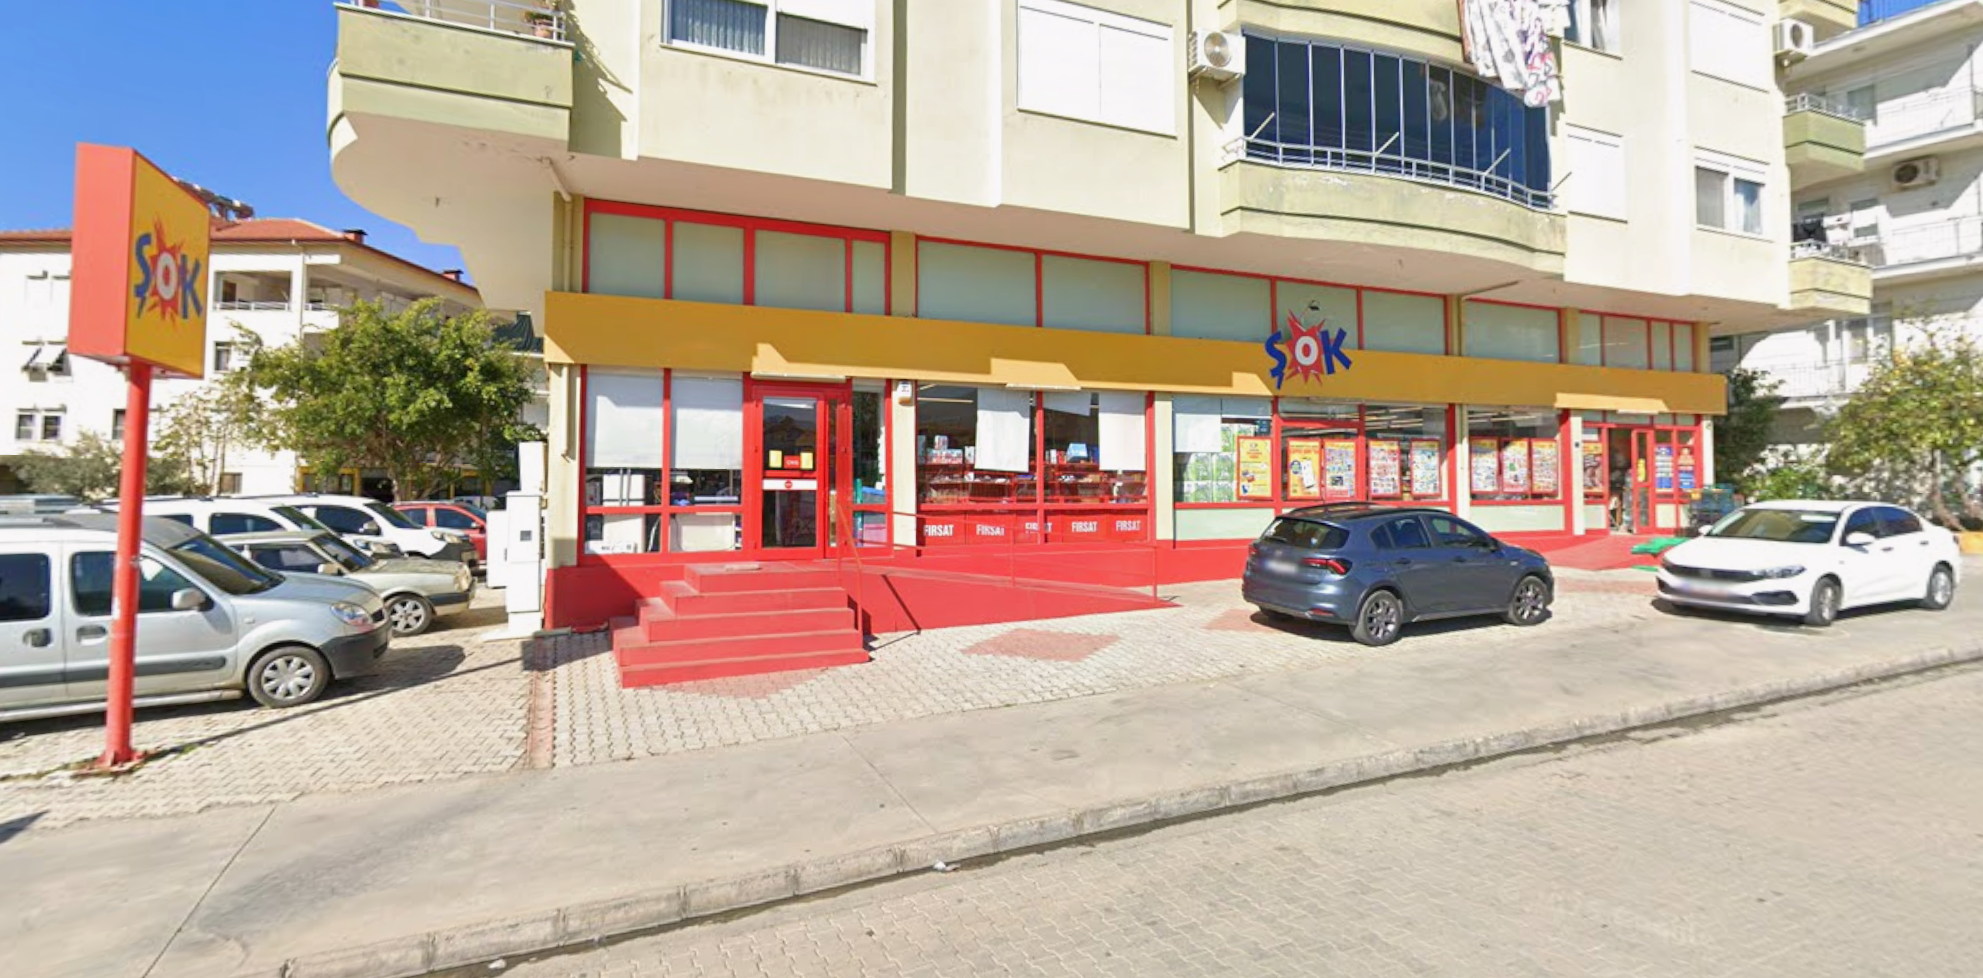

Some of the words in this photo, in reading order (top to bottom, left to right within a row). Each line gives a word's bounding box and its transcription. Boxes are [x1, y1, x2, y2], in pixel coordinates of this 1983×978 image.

[134, 232, 203, 319] ŞOK
[1265, 327, 1353, 390] ŞOK
[924, 524, 954, 536] FIRSAT
[1072, 521, 1098, 532] FIRSAT
[1116, 520, 1142, 532] FIRSAT
